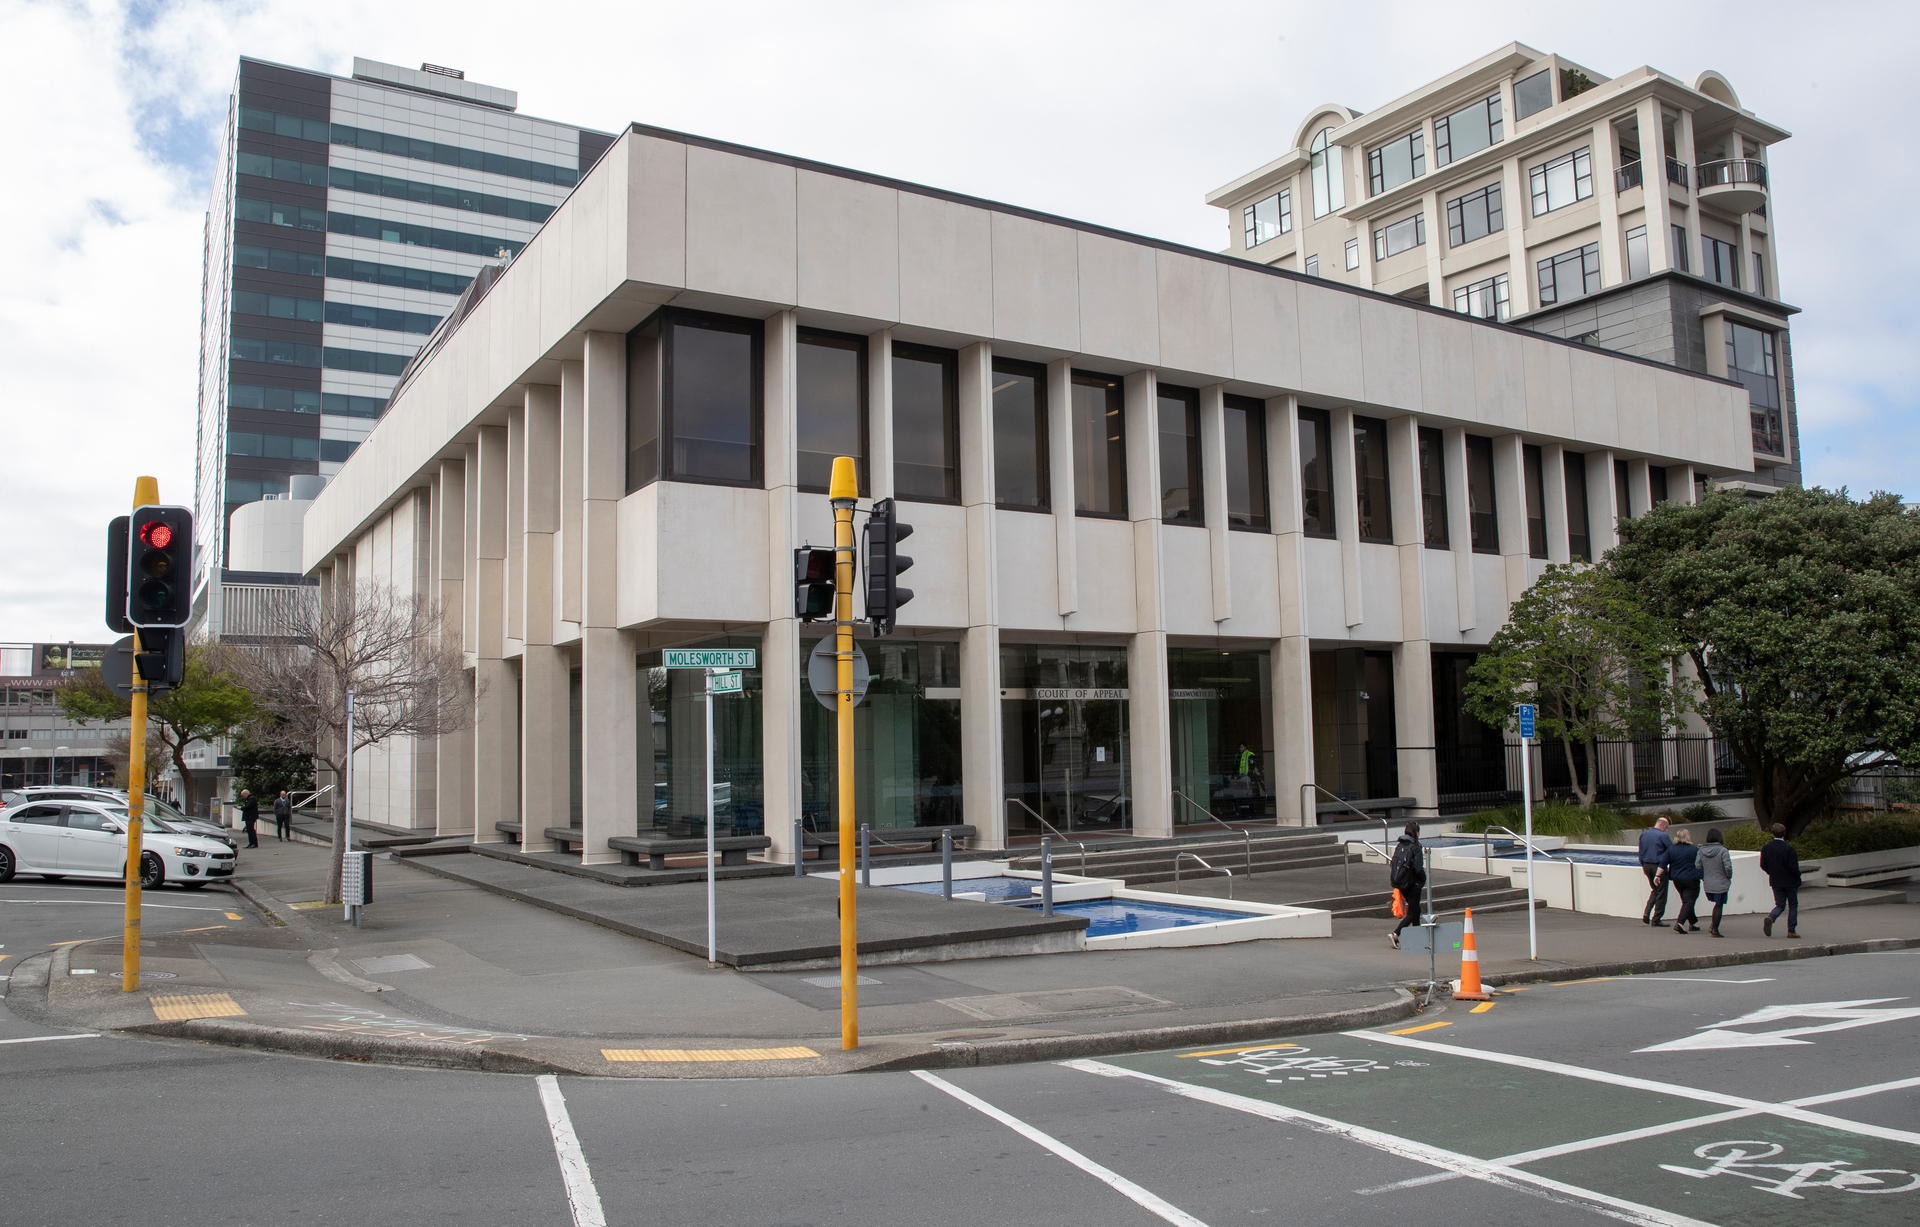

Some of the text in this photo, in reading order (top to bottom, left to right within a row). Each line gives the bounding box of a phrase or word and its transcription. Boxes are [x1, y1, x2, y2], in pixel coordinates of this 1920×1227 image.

[669, 652, 749, 666] MOLESWORTH ST
[714, 675, 738, 690] HILL ST
[845, 693, 852, 702] 3
[1037, 689, 1123, 699] COURT OF APPEAL
